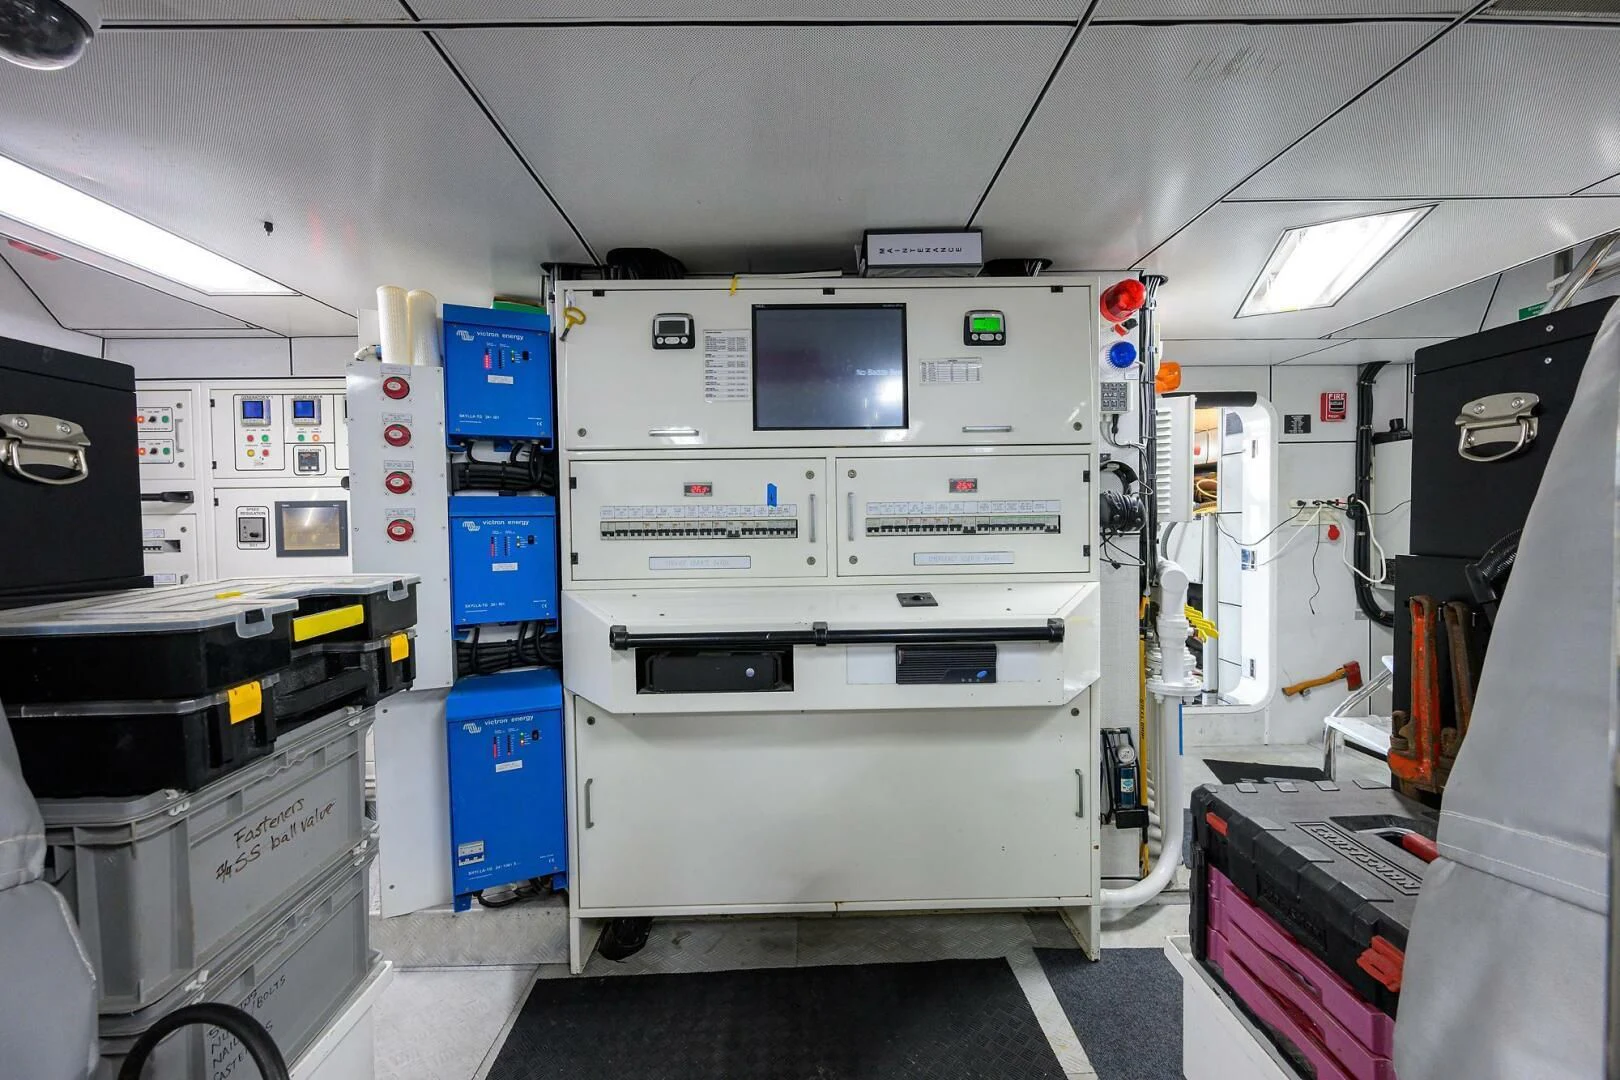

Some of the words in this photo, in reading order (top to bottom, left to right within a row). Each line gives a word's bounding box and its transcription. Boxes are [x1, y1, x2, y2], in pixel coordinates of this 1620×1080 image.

[878, 247, 963, 255] MAINTENANCE
[477, 331, 499, 339] victron
[502, 333, 524, 341] energy
[507, 519, 530, 527] energy
[484, 718, 508, 727] victron
[511, 715, 534, 724] energy
[233, 798, 305, 849] Fasteners
[270, 822, 297, 851] ball
[1310, 828, 1421, 890] CRAFTSMAN
